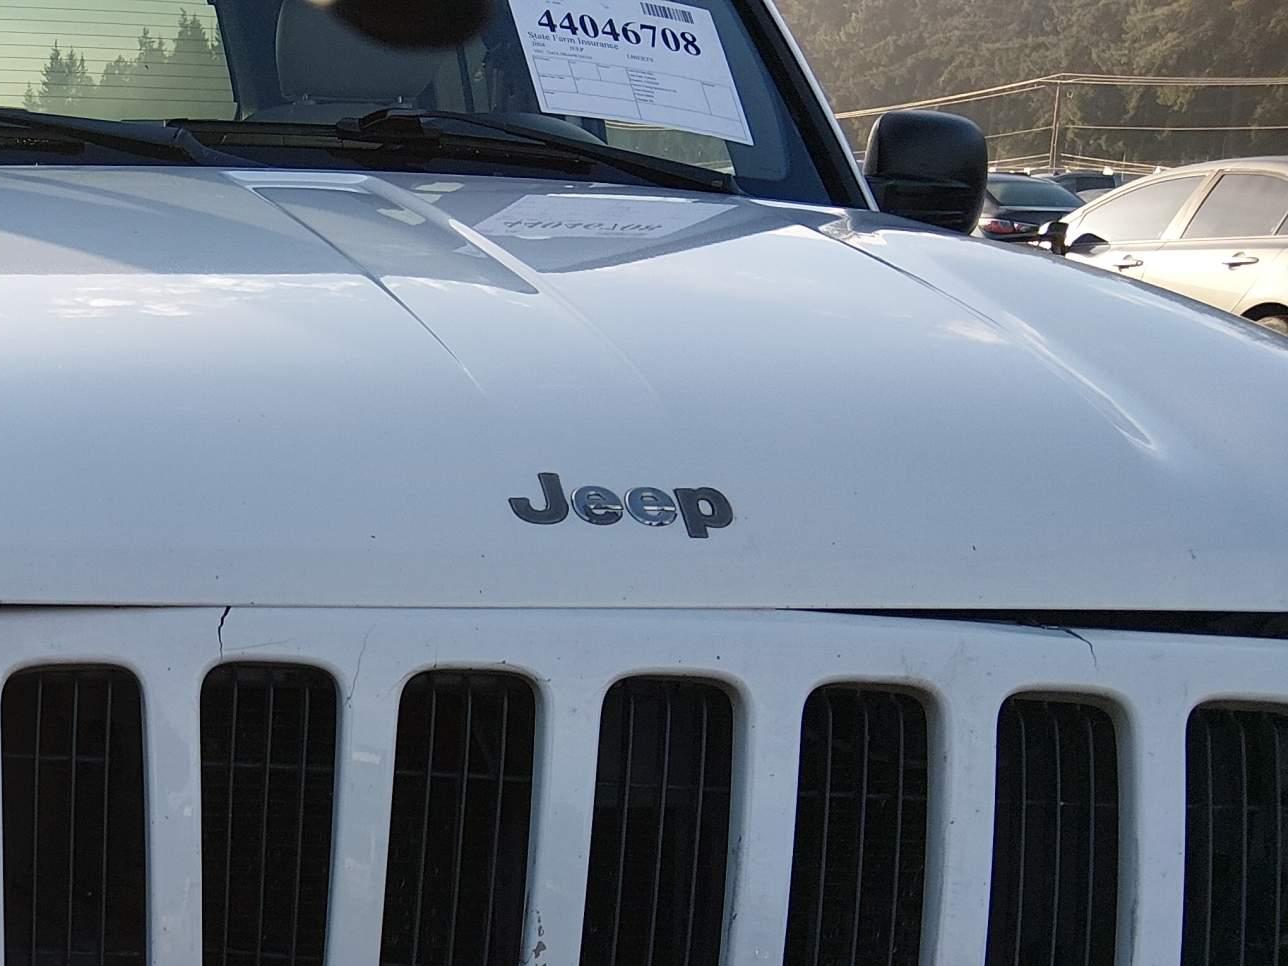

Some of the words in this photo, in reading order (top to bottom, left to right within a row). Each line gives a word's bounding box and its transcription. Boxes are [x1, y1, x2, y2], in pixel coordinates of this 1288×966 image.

[527, 31, 551, 41] State
[552, 33, 576, 45] Farm
[578, 37, 619, 50] Insurance
[537, 8, 702, 57] 44046708
[507, 471, 734, 539] Jeep
